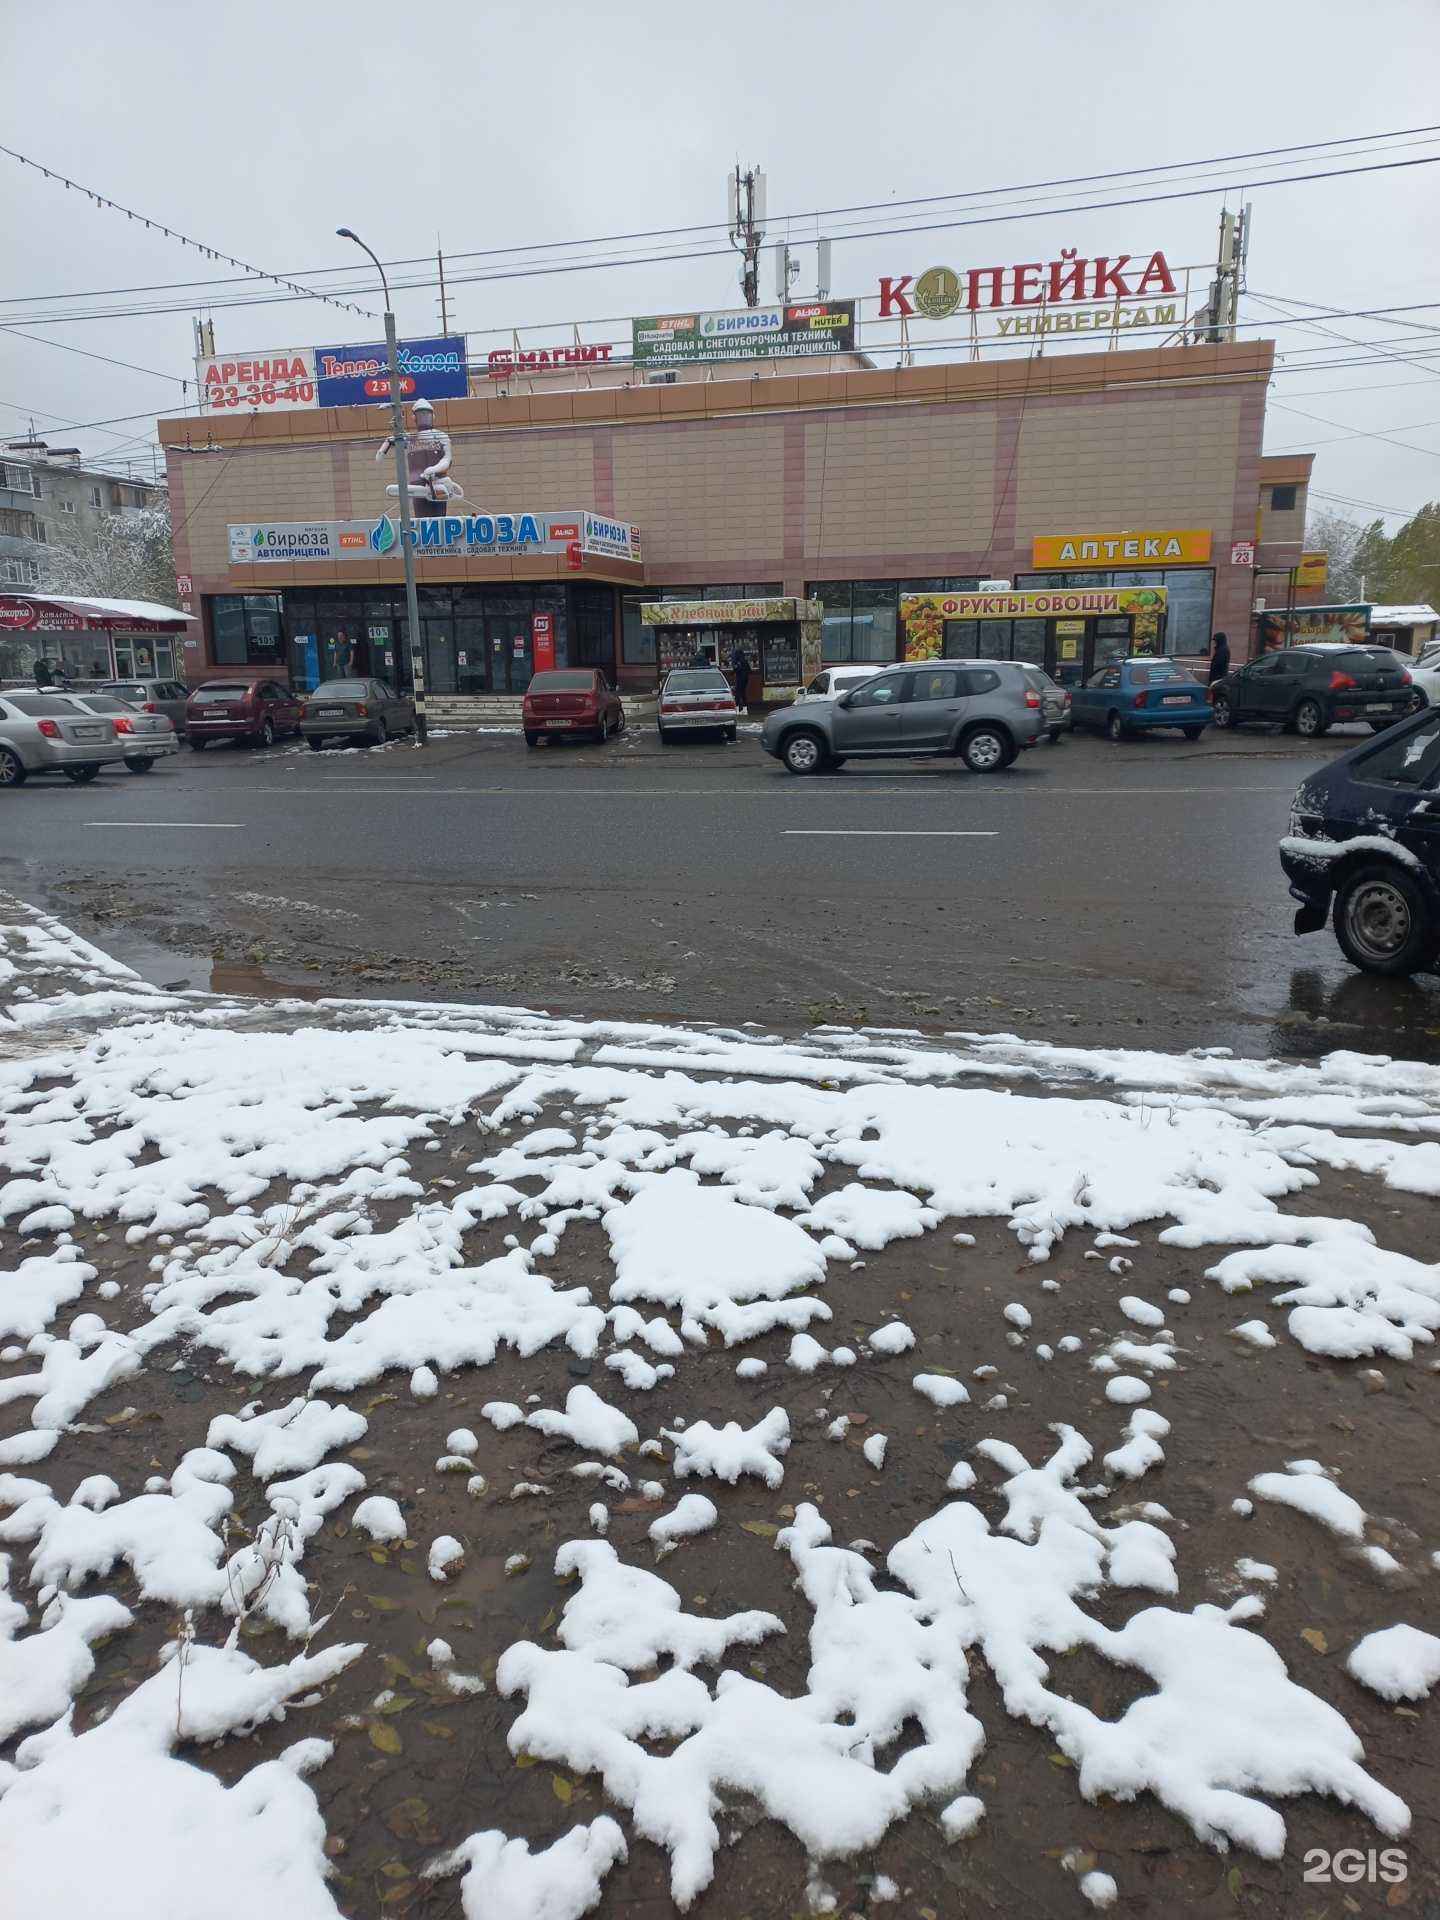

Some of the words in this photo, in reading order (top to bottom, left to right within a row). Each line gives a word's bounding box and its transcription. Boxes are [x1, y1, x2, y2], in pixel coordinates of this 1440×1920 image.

[660, 319, 691, 330] STIHL
[716, 313, 780, 331] БИРЮЗА
[996, 303, 1177, 337] УНИВЕРСАМ
[653, 341, 695, 353] САДОВАЯ
[697, 340, 704, 350] И
[706, 331, 790, 348] СНЕГОУБОРОЧНАЯ
[792, 330, 833, 341] ТЕХНИКА
[698, 348, 757, 360] МОТОЦИКЛЫ
[768, 341, 841, 356] КВАДРОЦИКЛЫ
[517, 345, 613, 372] МАГНИТ
[205, 357, 308, 384] АРЕНДА
[380, 380, 408, 392] этж
[267, 531, 329, 548] бирюза
[593, 520, 627, 543] БИРЮЗА
[257, 547, 330, 558] АВТОПРИЦЕПЫ
[1059, 537, 1183, 561] АПТЕКА
[1235, 552, 1249, 563] 23
[180, 583, 190, 592] 23
[942, 593, 1119, 615] ФРУКТЫ-ОВОЩИ
